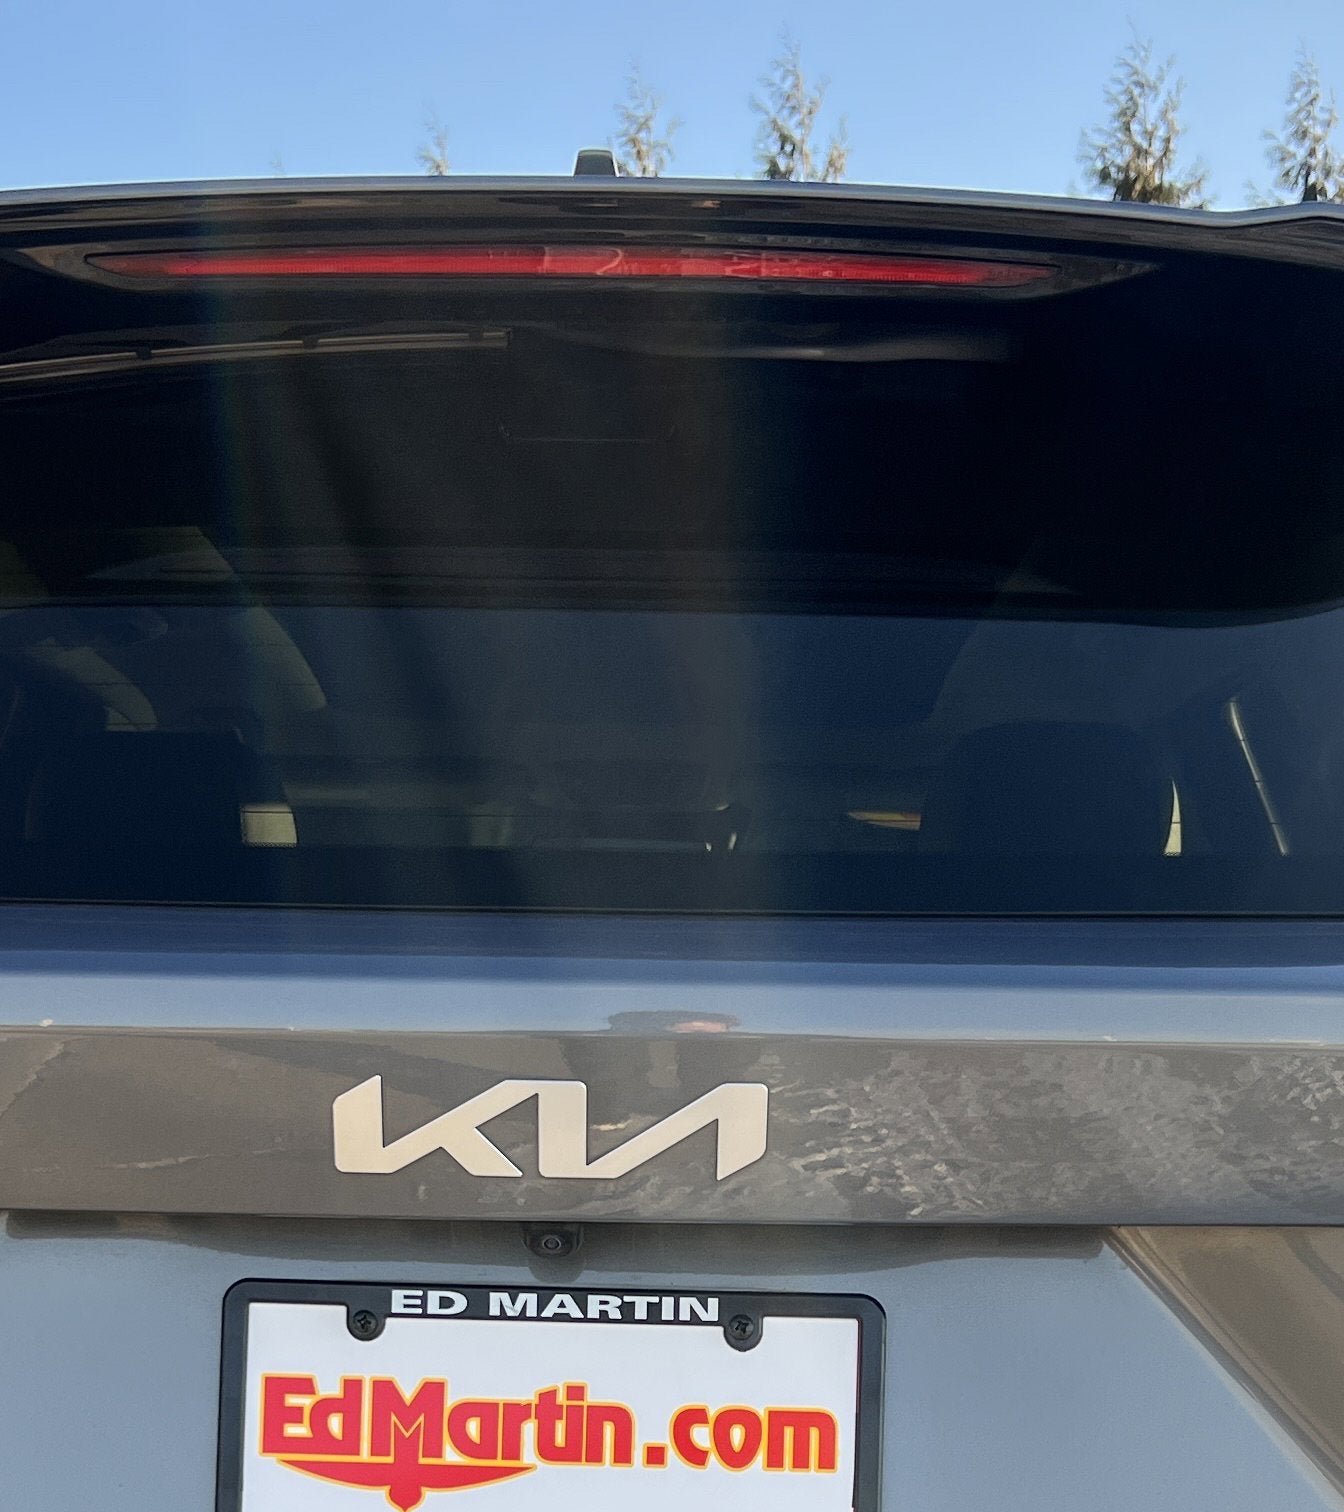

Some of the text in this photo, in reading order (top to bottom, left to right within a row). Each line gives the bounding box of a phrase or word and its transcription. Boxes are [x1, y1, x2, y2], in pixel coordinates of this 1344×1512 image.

[332, 1074, 769, 1181] KIA
[390, 1289, 721, 1323] ED MARTIN
[258, 1372, 839, 1474] EdMartin.com
